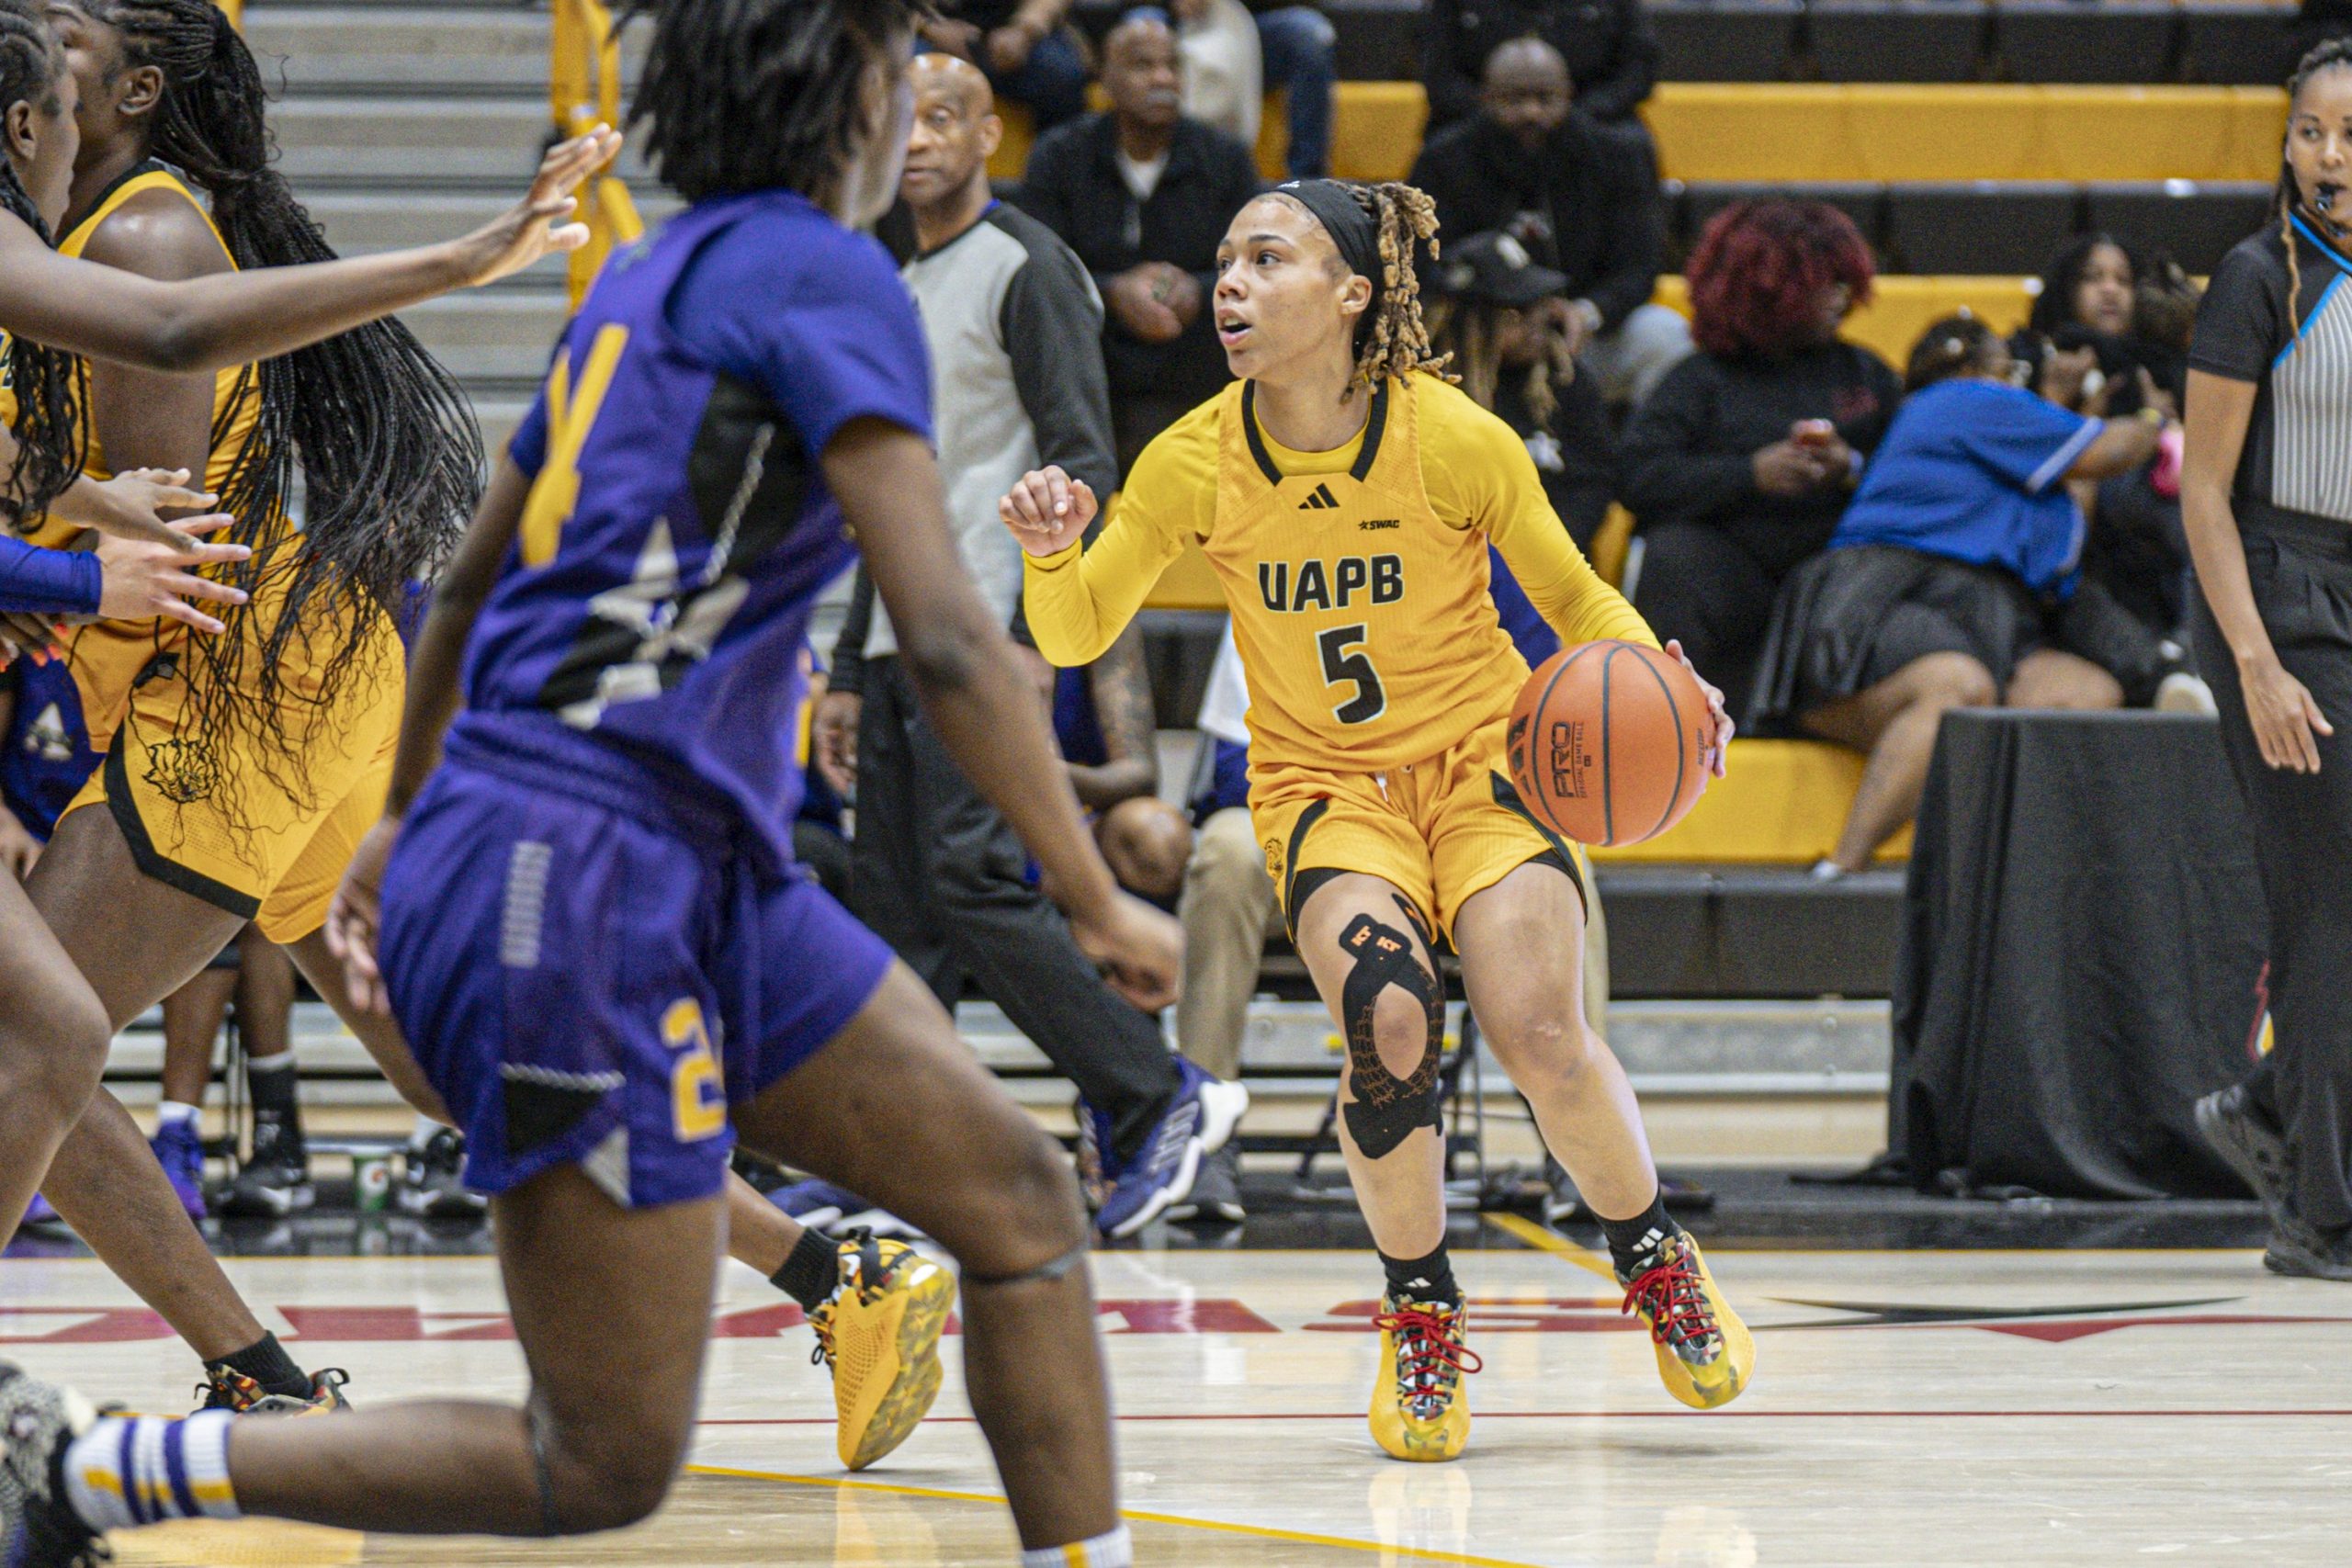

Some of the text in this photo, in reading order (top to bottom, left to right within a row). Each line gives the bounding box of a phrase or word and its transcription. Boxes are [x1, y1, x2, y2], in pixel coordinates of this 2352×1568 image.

[1370, 519, 1400, 531] SWAC
[1258, 553, 1404, 613] UAPB
[1316, 622, 1387, 725] 5
[1551, 721, 1575, 798] PRO
[659, 996, 728, 1143] 2
